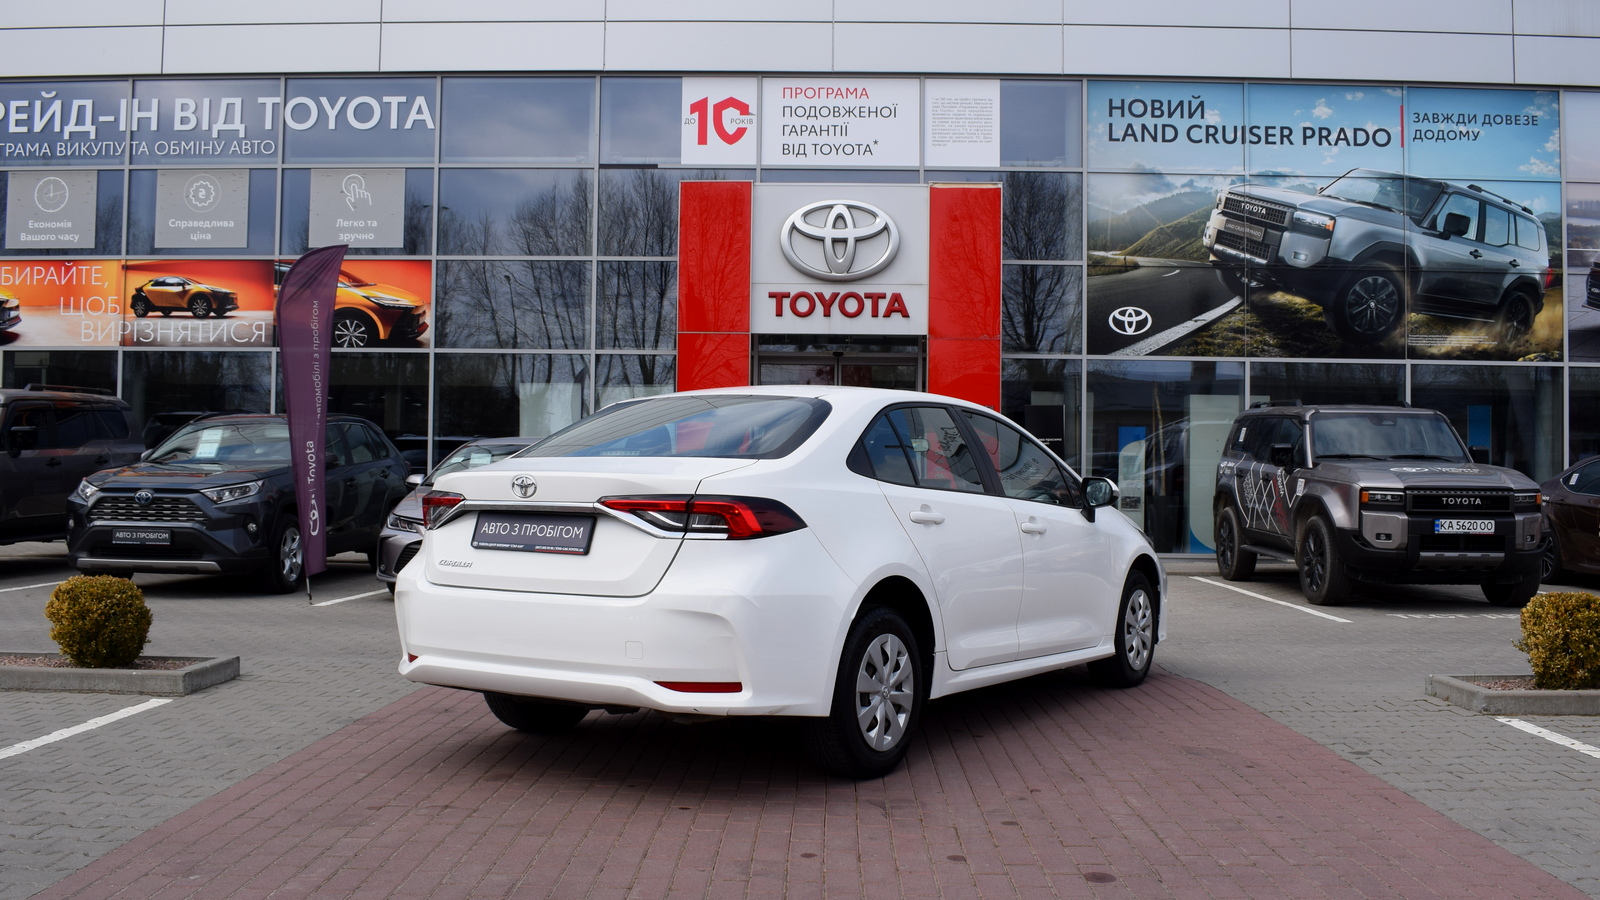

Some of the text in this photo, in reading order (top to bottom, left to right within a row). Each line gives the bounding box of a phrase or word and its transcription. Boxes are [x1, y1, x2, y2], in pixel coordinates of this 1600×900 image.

[783, 87, 869, 99] ПРОГРАМА
[782, 103, 898, 120] ПОДОВЖЕНОЇ
[1108, 95, 1205, 119] НОВИЙ
[0, 91, 435, 140] ЕЙД-ІН ВІД TOYOTA
[1413, 112, 1538, 127] ЗАВЖДИ ДОВЕЗЕ
[782, 121, 849, 137] ГАРАНТІЇ
[1108, 122, 1392, 147] LAND CRUISER PRADO
[1413, 129, 1480, 143] ДОДОМУ
[56, 142, 126, 156] ВИКУПУ
[130, 141, 149, 155] ТА
[154, 140, 225, 155] ОБМІНУ
[229, 140, 276, 155] АВТО
[782, 143, 807, 158] ВІД
[1241, 203, 1266, 214] TOYOTA
[28, 220, 72, 229] Економія
[168, 219, 234, 229] Справедлива
[336, 219, 365, 227] Легко
[20, 232, 80, 242] Вашого часу
[190, 231, 212, 241] ціна
[339, 233, 375, 241] зручно
[60, 296, 120, 319] ЩОБ
[768, 291, 910, 318] TOYOTA
[81, 321, 266, 344] ВИРІЗНЯТИСЯ
[310, 300, 319, 350] пробігом
[1442, 497, 1482, 505] TOYOTA
[480, 522, 510, 535] АВТО
[521, 524, 584, 539] ПРОБІГОМ
[1440, 521, 1454, 531] KA
[1456, 521, 1478, 531] 5620
[439, 559, 473, 568] COROLLA
